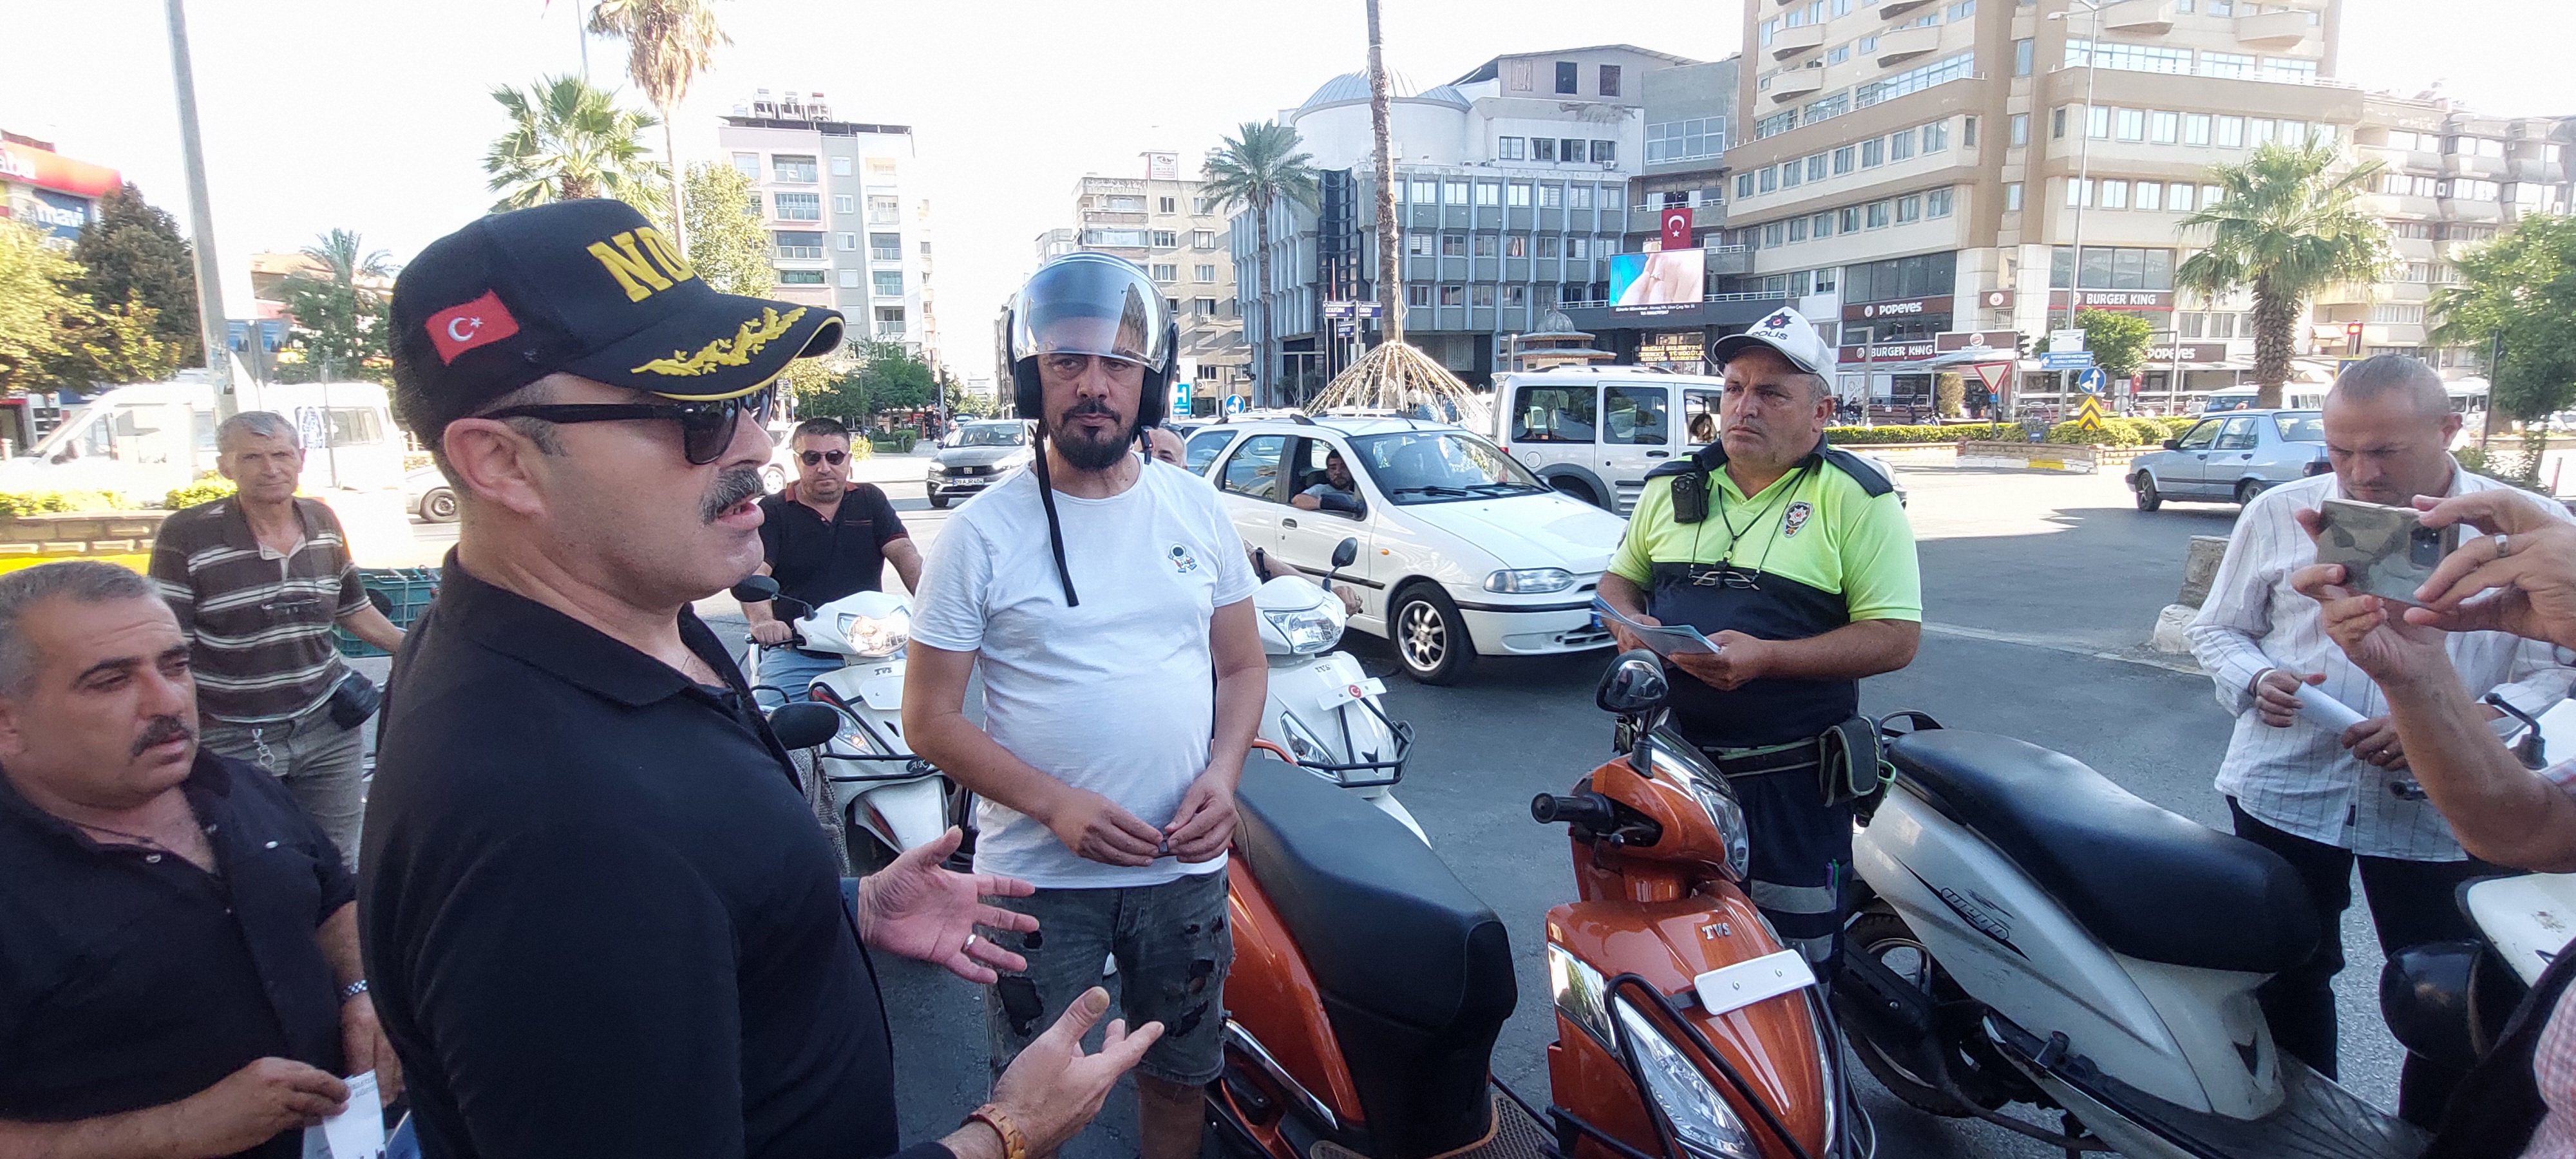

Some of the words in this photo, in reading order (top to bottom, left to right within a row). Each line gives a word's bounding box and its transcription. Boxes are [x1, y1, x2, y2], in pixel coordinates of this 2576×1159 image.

[2087, 293, 2126, 305] BURGER
[2130, 294, 2155, 305] KING
[1871, 346, 1906, 357] BURGER
[1908, 344, 1933, 355] KING
[1174, 386, 1187, 403] H
[1314, 664, 1331, 673] TVS
[1701, 922, 1731, 940] TVS
